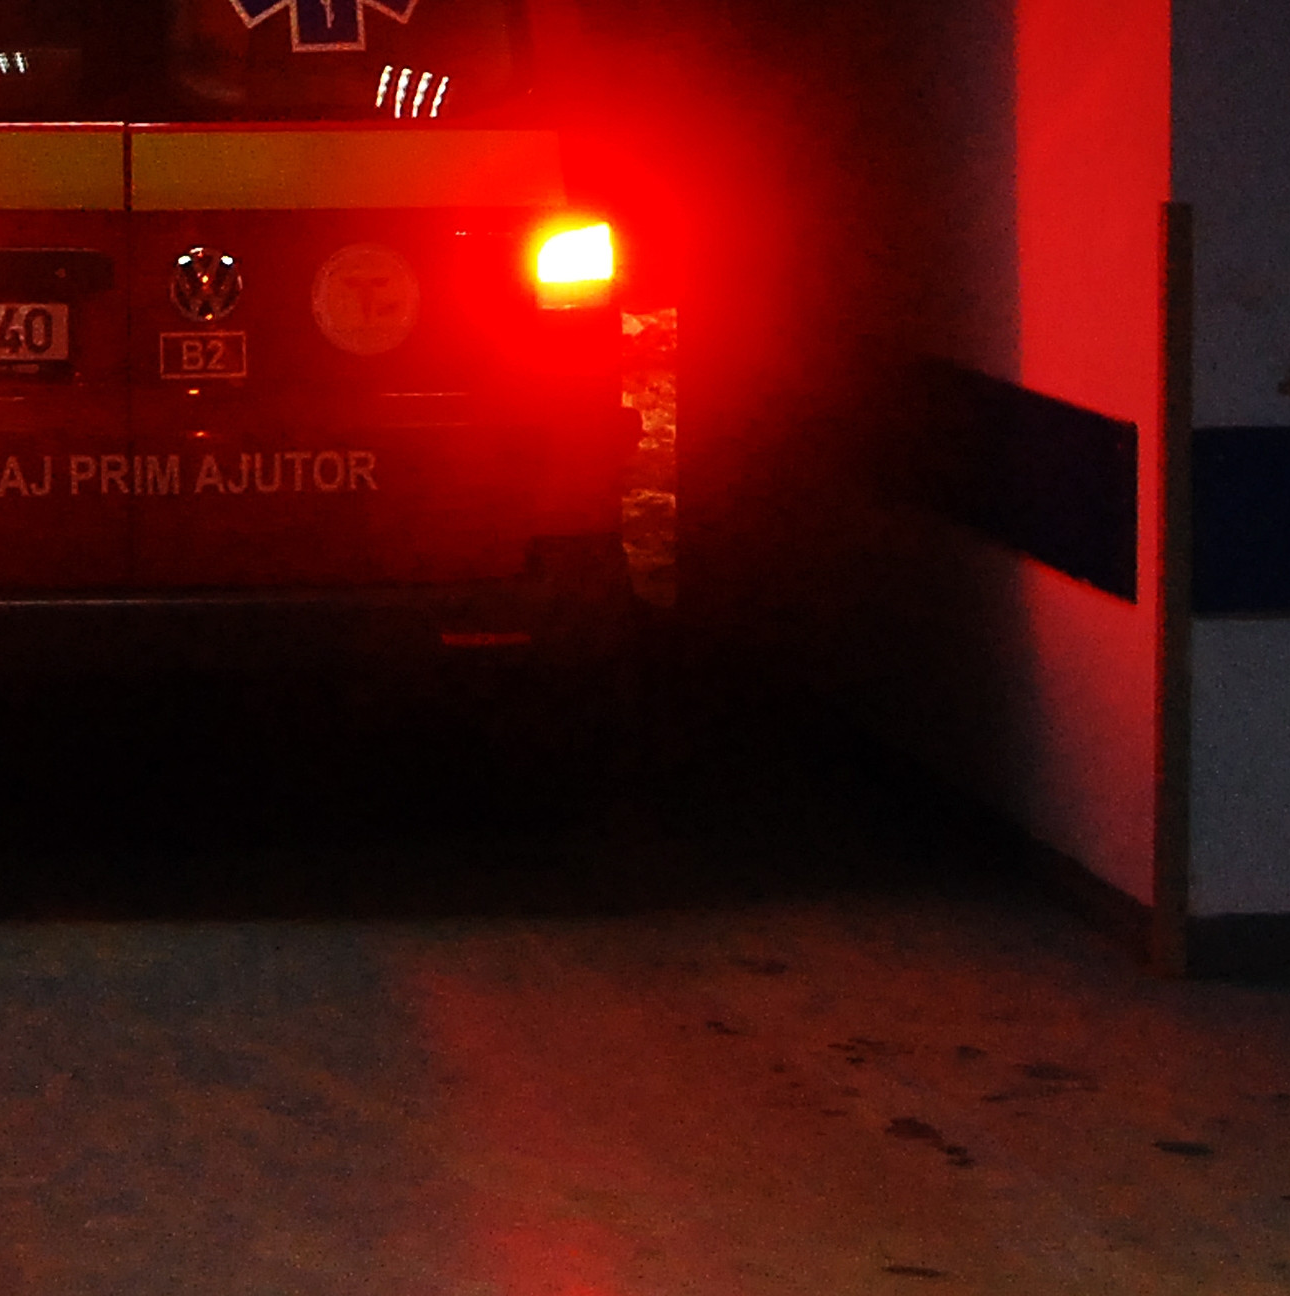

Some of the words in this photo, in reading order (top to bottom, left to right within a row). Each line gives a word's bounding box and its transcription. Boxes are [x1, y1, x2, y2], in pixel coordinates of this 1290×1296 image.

[180, 339, 227, 373] B2
[69, 453, 181, 497] PRIM
[193, 450, 379, 495] AJUTOR
